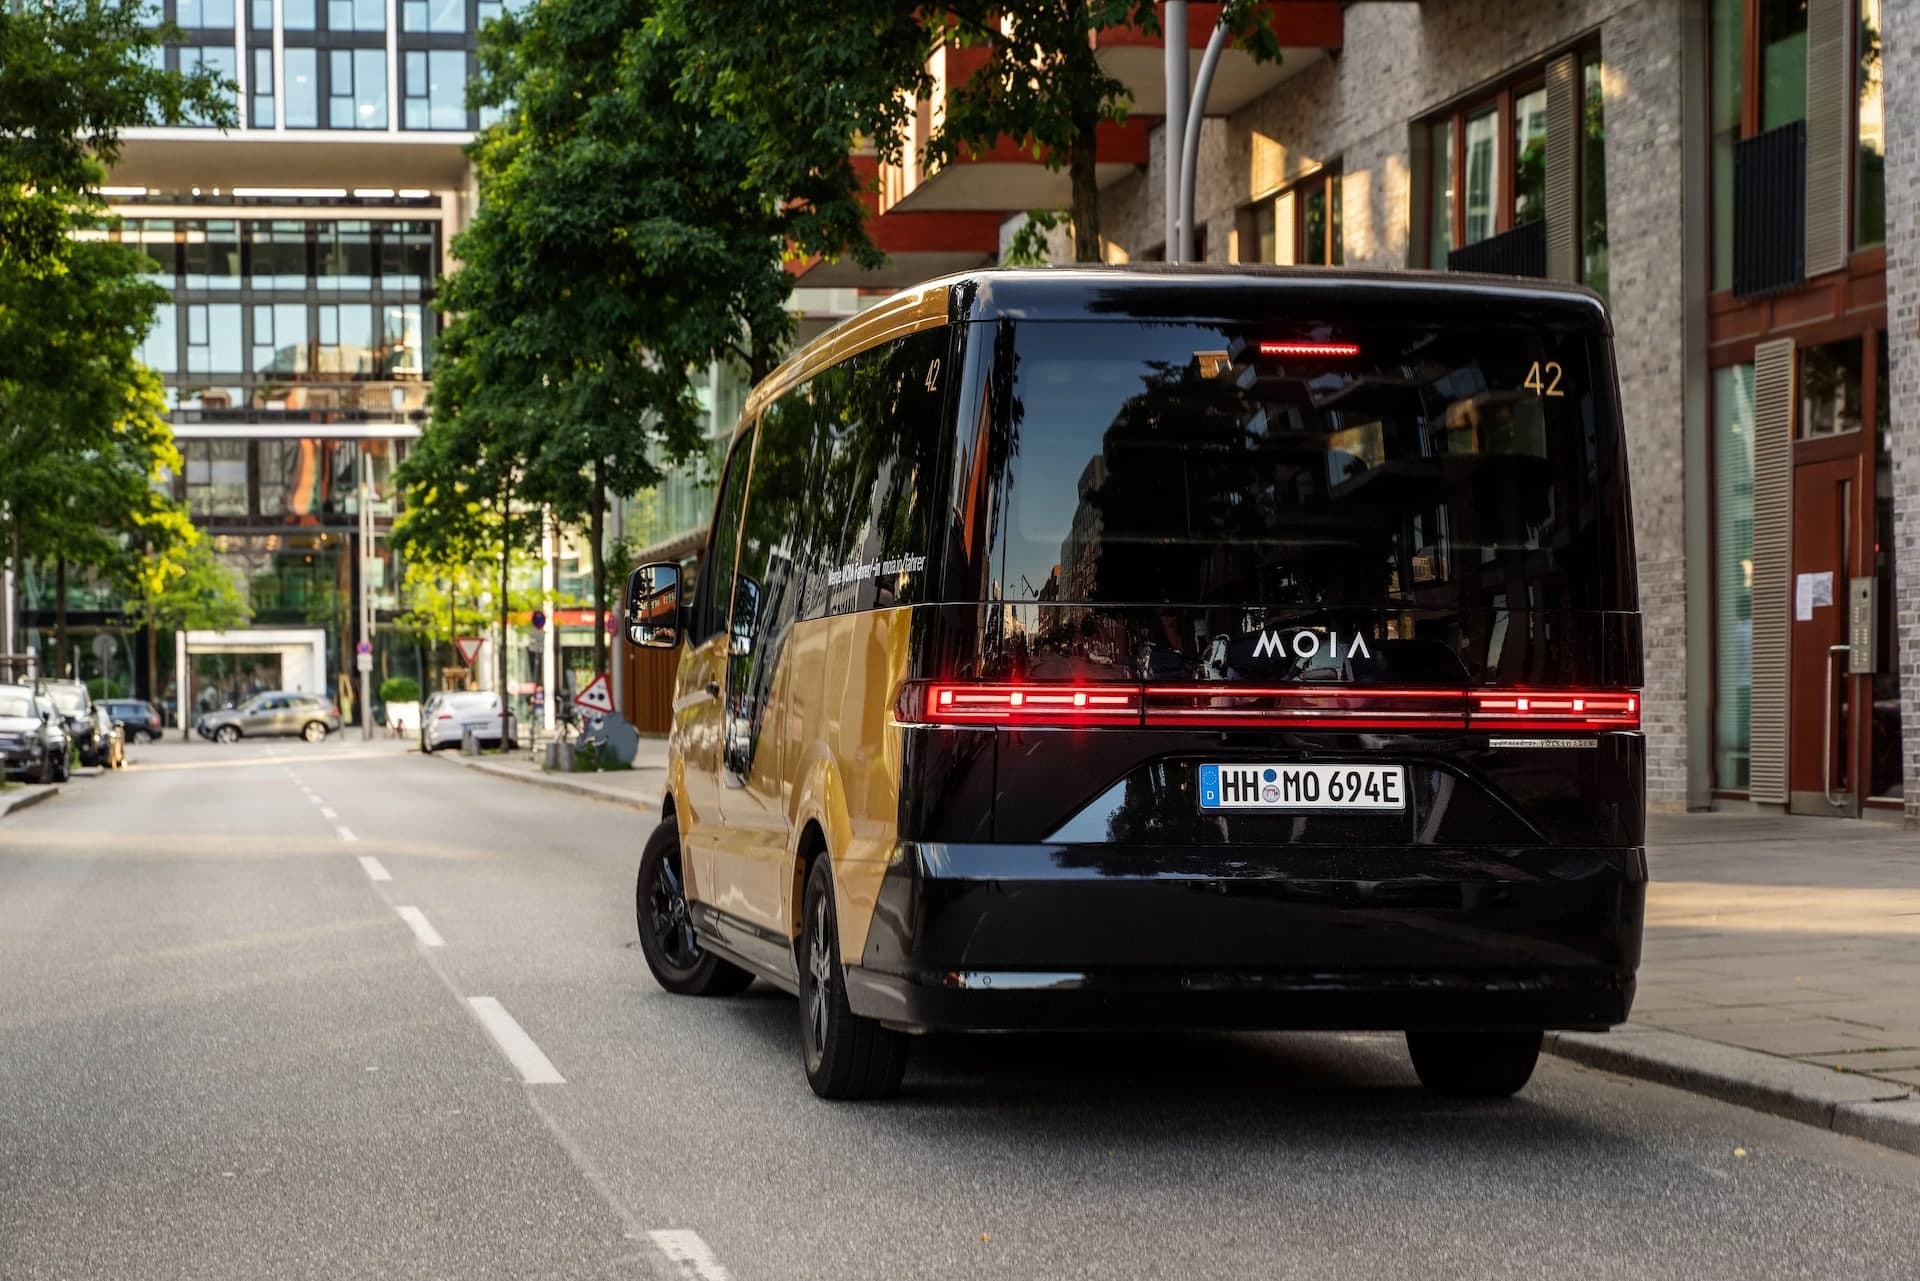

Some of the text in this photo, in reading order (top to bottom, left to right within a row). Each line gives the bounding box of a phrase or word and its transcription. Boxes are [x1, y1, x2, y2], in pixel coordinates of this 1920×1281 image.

[925, 358, 940, 392] 42
[1524, 361, 1564, 397] 42
[1252, 630, 1371, 658] MOIA
[1206, 790, 1214, 800] D
[1222, 770, 1400, 803] HH MO 694E
